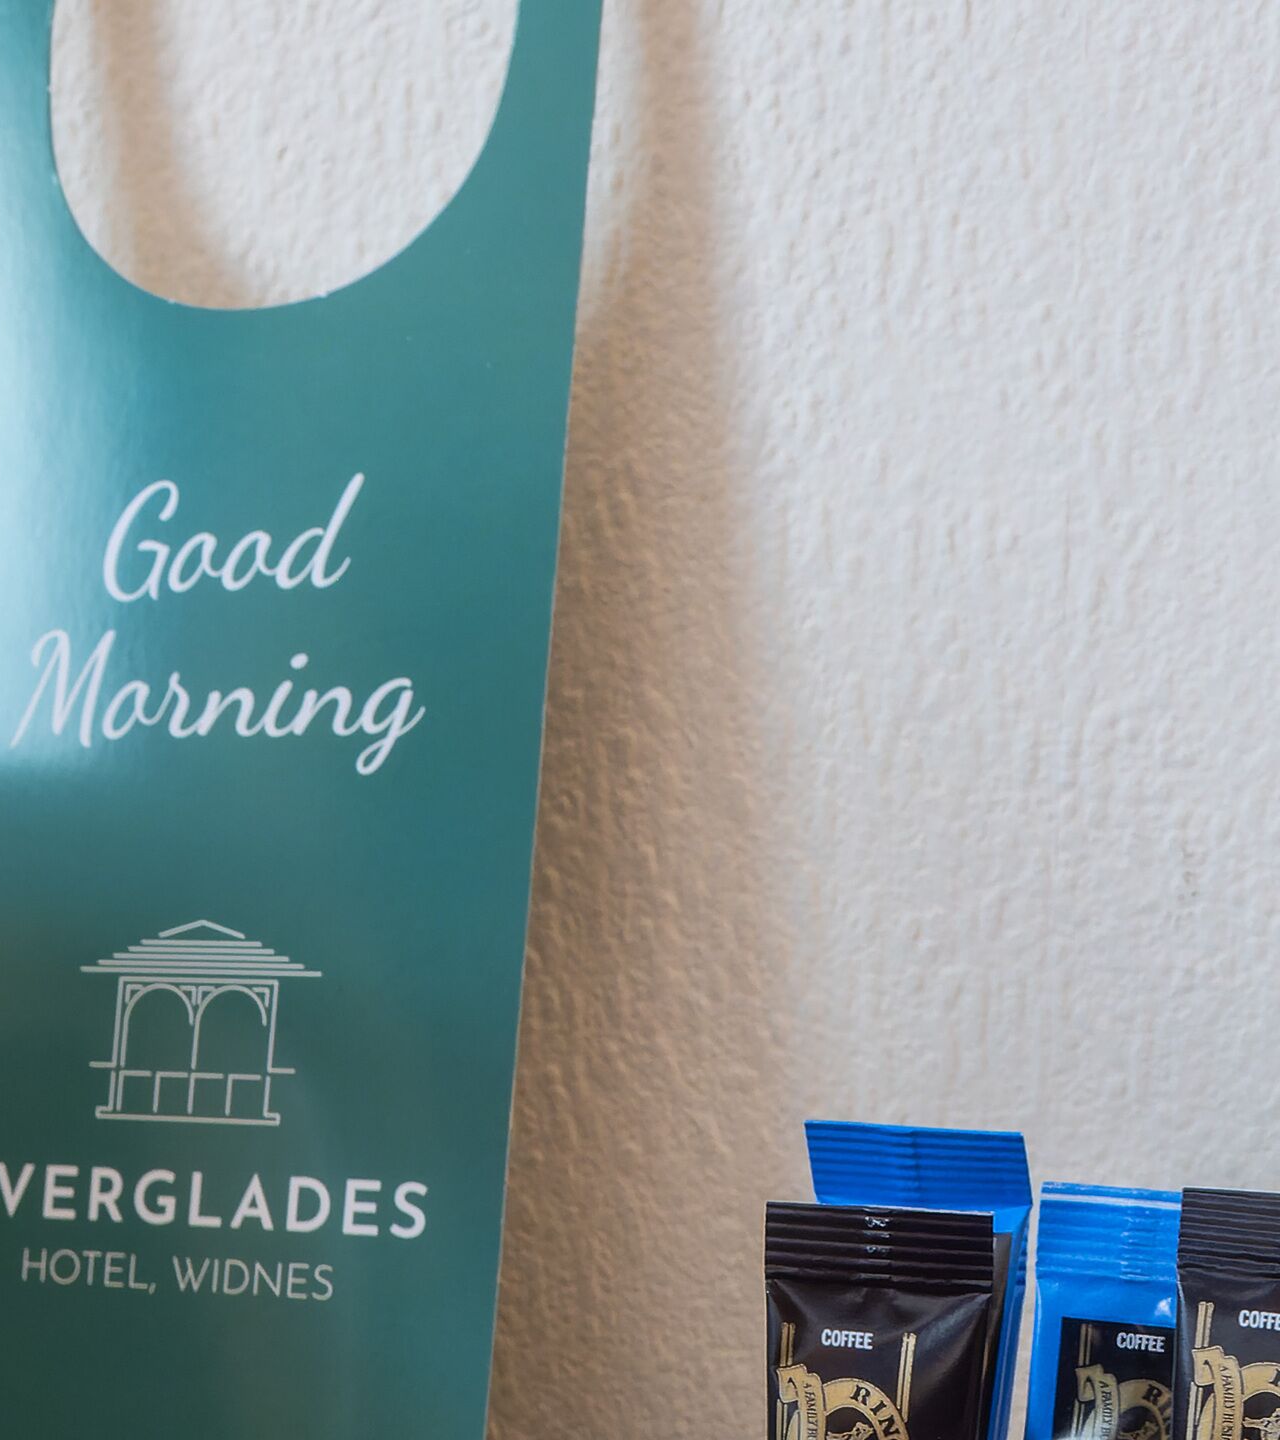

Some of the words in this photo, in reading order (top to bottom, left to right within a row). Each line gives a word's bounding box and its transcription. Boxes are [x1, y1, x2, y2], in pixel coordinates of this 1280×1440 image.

[101, 472, 365, 603] Good
[9, 628, 427, 776] Morning
[20, 1246, 157, 1295] HOTEL,
[171, 1254, 335, 1301] WIDNES
[821, 1328, 874, 1350] COFFEE
[1238, 1309, 1280, 1332] COFFE
[1116, 1331, 1166, 1353] COFFEE
[1221, 1374, 1236, 1411] FAMILY
